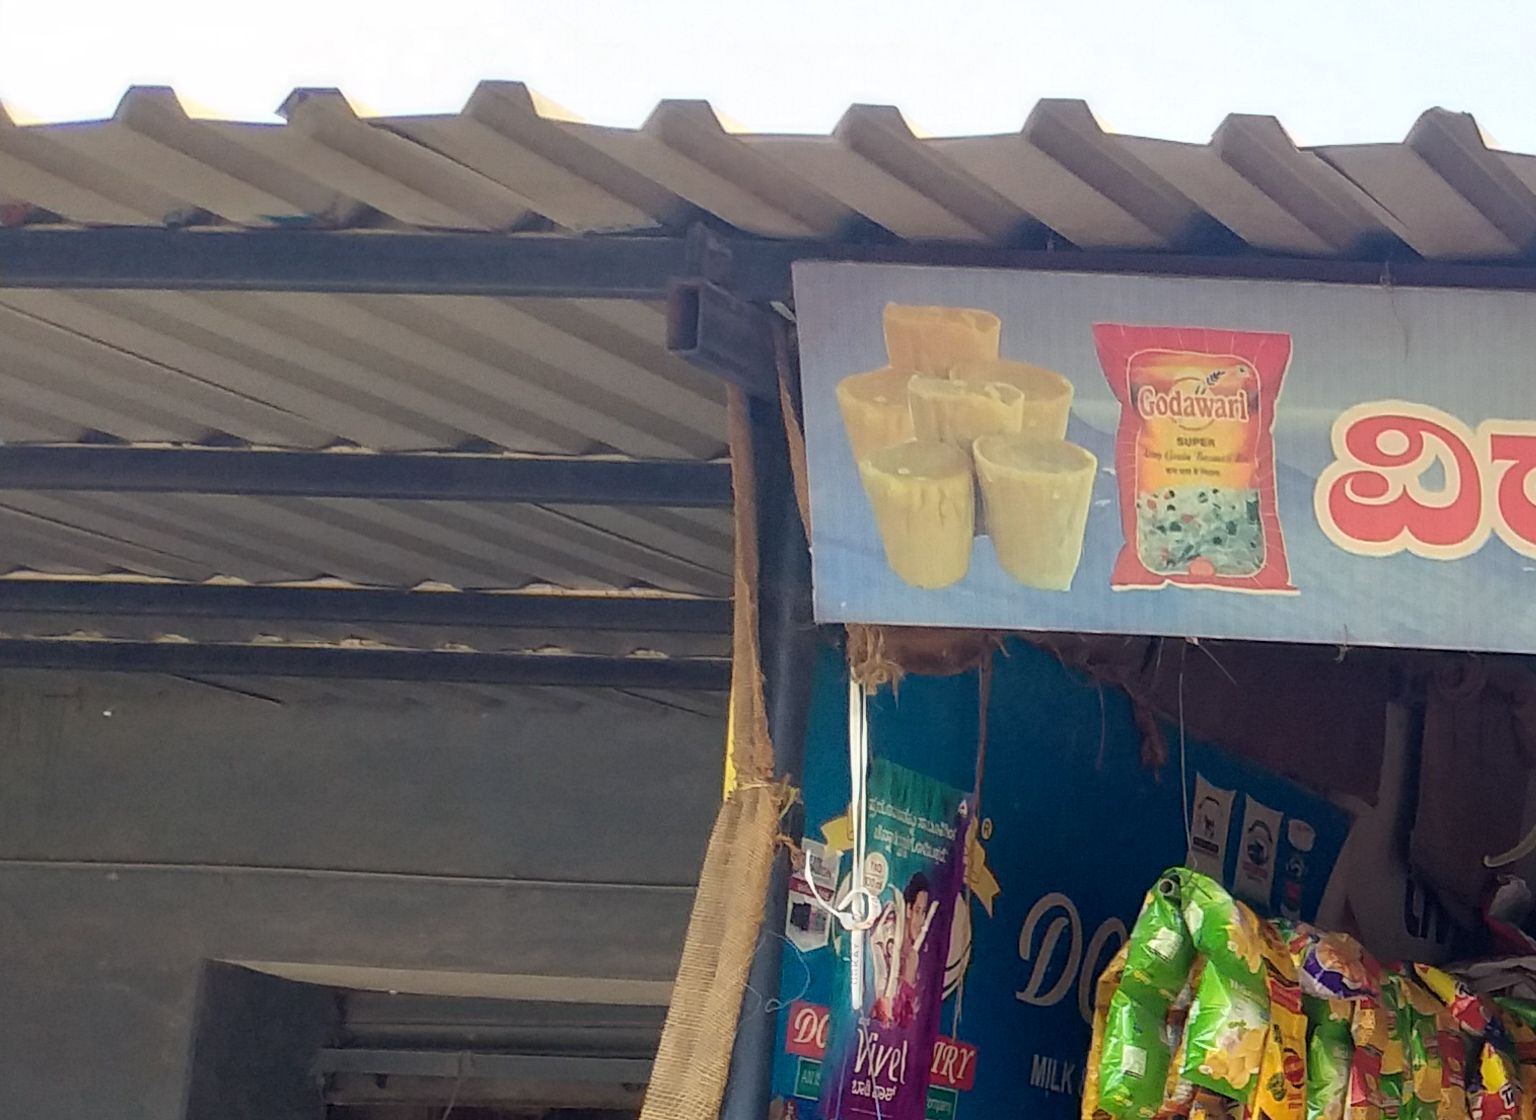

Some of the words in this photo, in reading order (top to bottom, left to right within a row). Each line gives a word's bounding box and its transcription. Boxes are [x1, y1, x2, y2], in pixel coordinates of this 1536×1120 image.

[1138, 386, 1249, 422] Godawari
[1176, 437, 1216, 448] SUPER
[853, 1028, 910, 1085] Vivel
[1029, 1054, 1077, 1094] MILK
